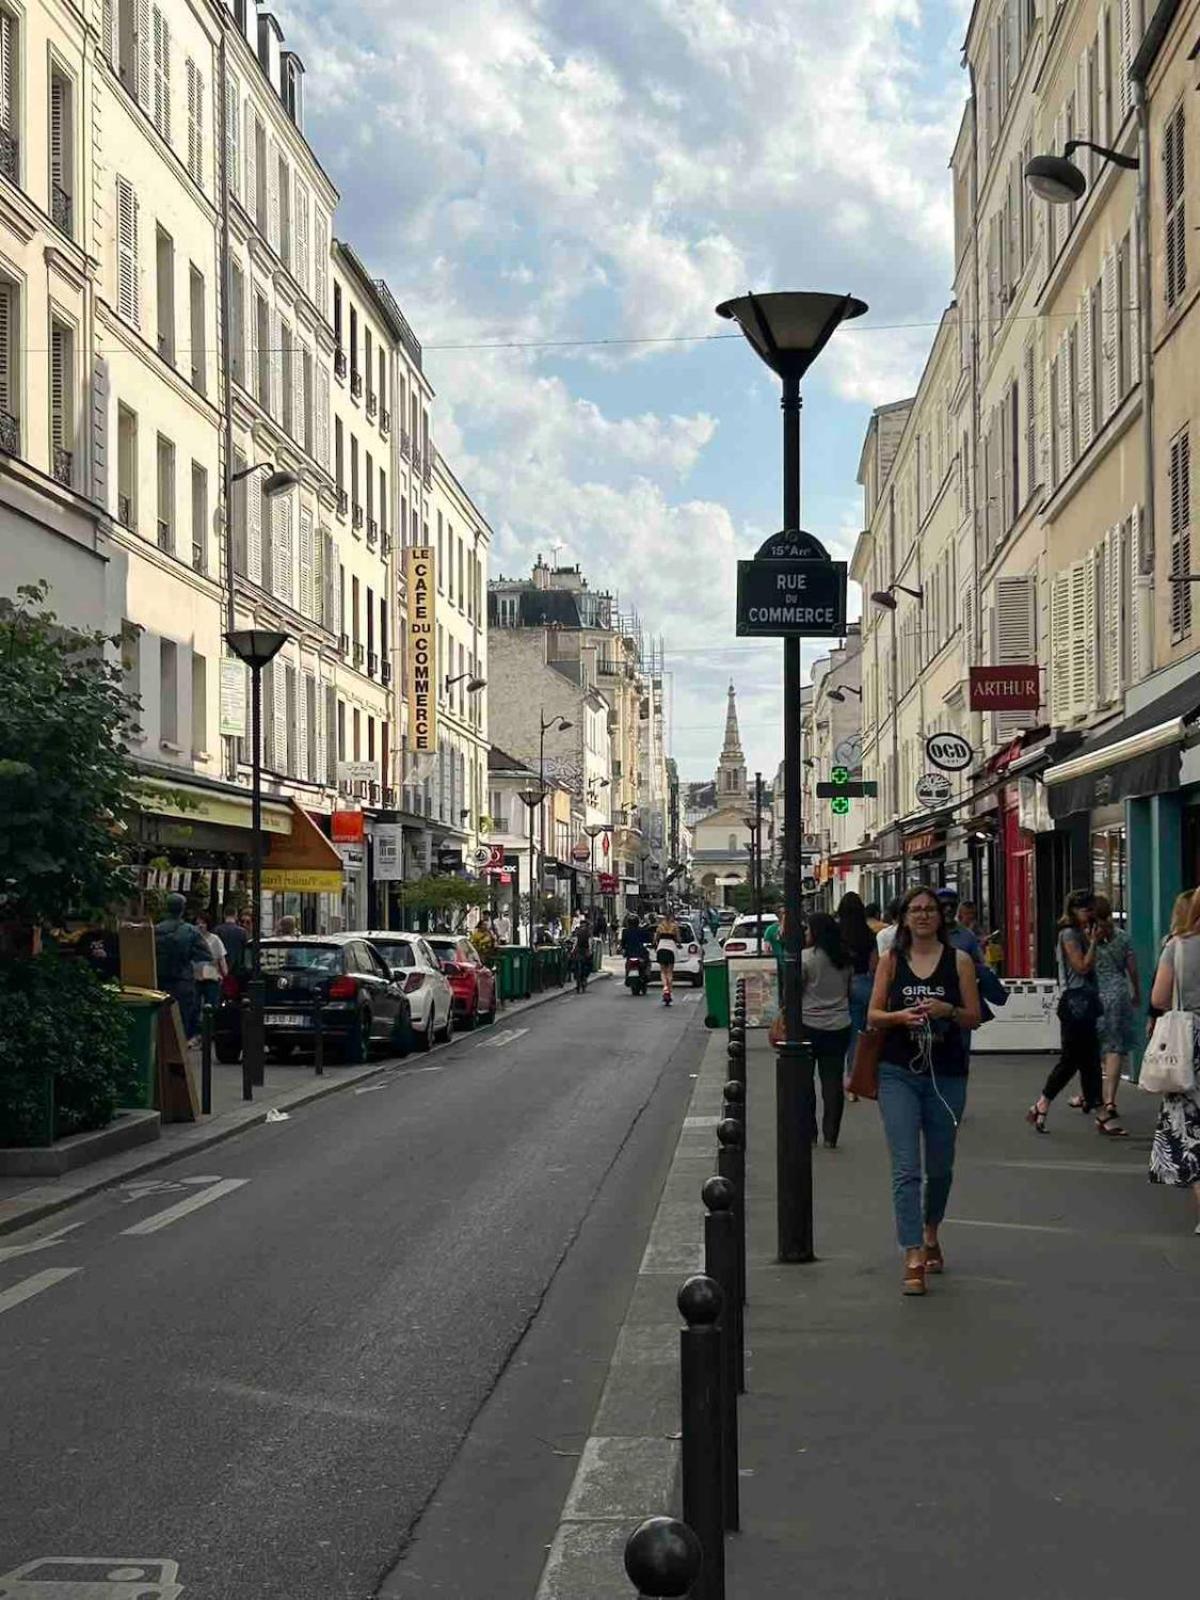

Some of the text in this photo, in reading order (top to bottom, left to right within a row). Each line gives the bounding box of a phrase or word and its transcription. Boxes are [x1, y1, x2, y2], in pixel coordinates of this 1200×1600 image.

[777, 574, 807, 590] RUE
[785, 594, 798, 604] DU
[749, 607, 834, 622] COMMERCE
[411, 550, 431, 749] LE CAFE DU COMMERCE
[973, 680, 1036, 696] ARTHUR
[902, 985, 945, 996] GIRLS
